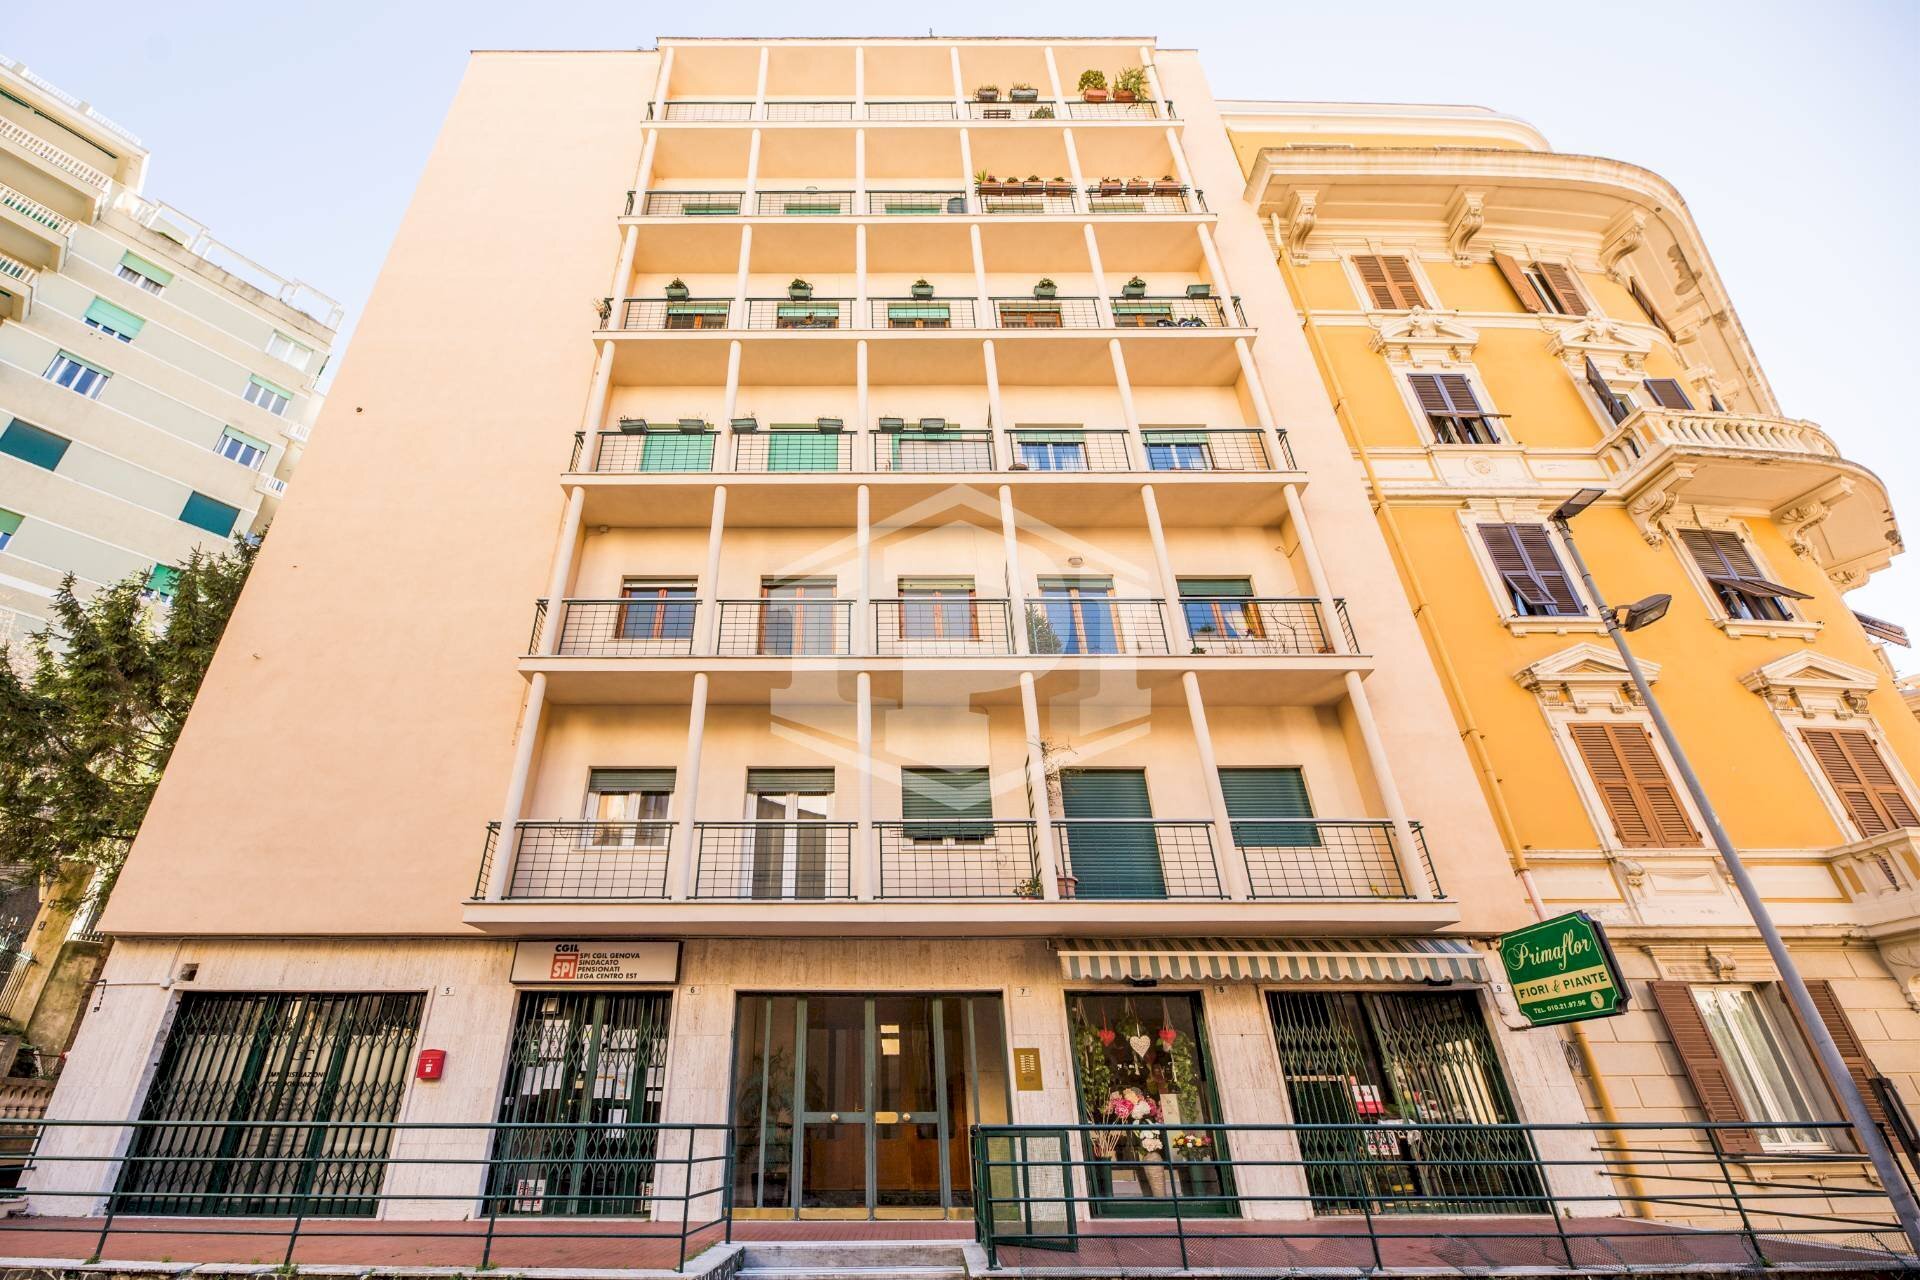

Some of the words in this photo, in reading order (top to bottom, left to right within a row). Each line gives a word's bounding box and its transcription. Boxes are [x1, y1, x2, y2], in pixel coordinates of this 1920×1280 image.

[556, 944, 579, 952] CGIL
[1506, 929, 1591, 970] Primaflor
[553, 962, 575, 978] SPI
[1519, 984, 1549, 998] FIORI
[1563, 972, 1607, 989] PIANTE
